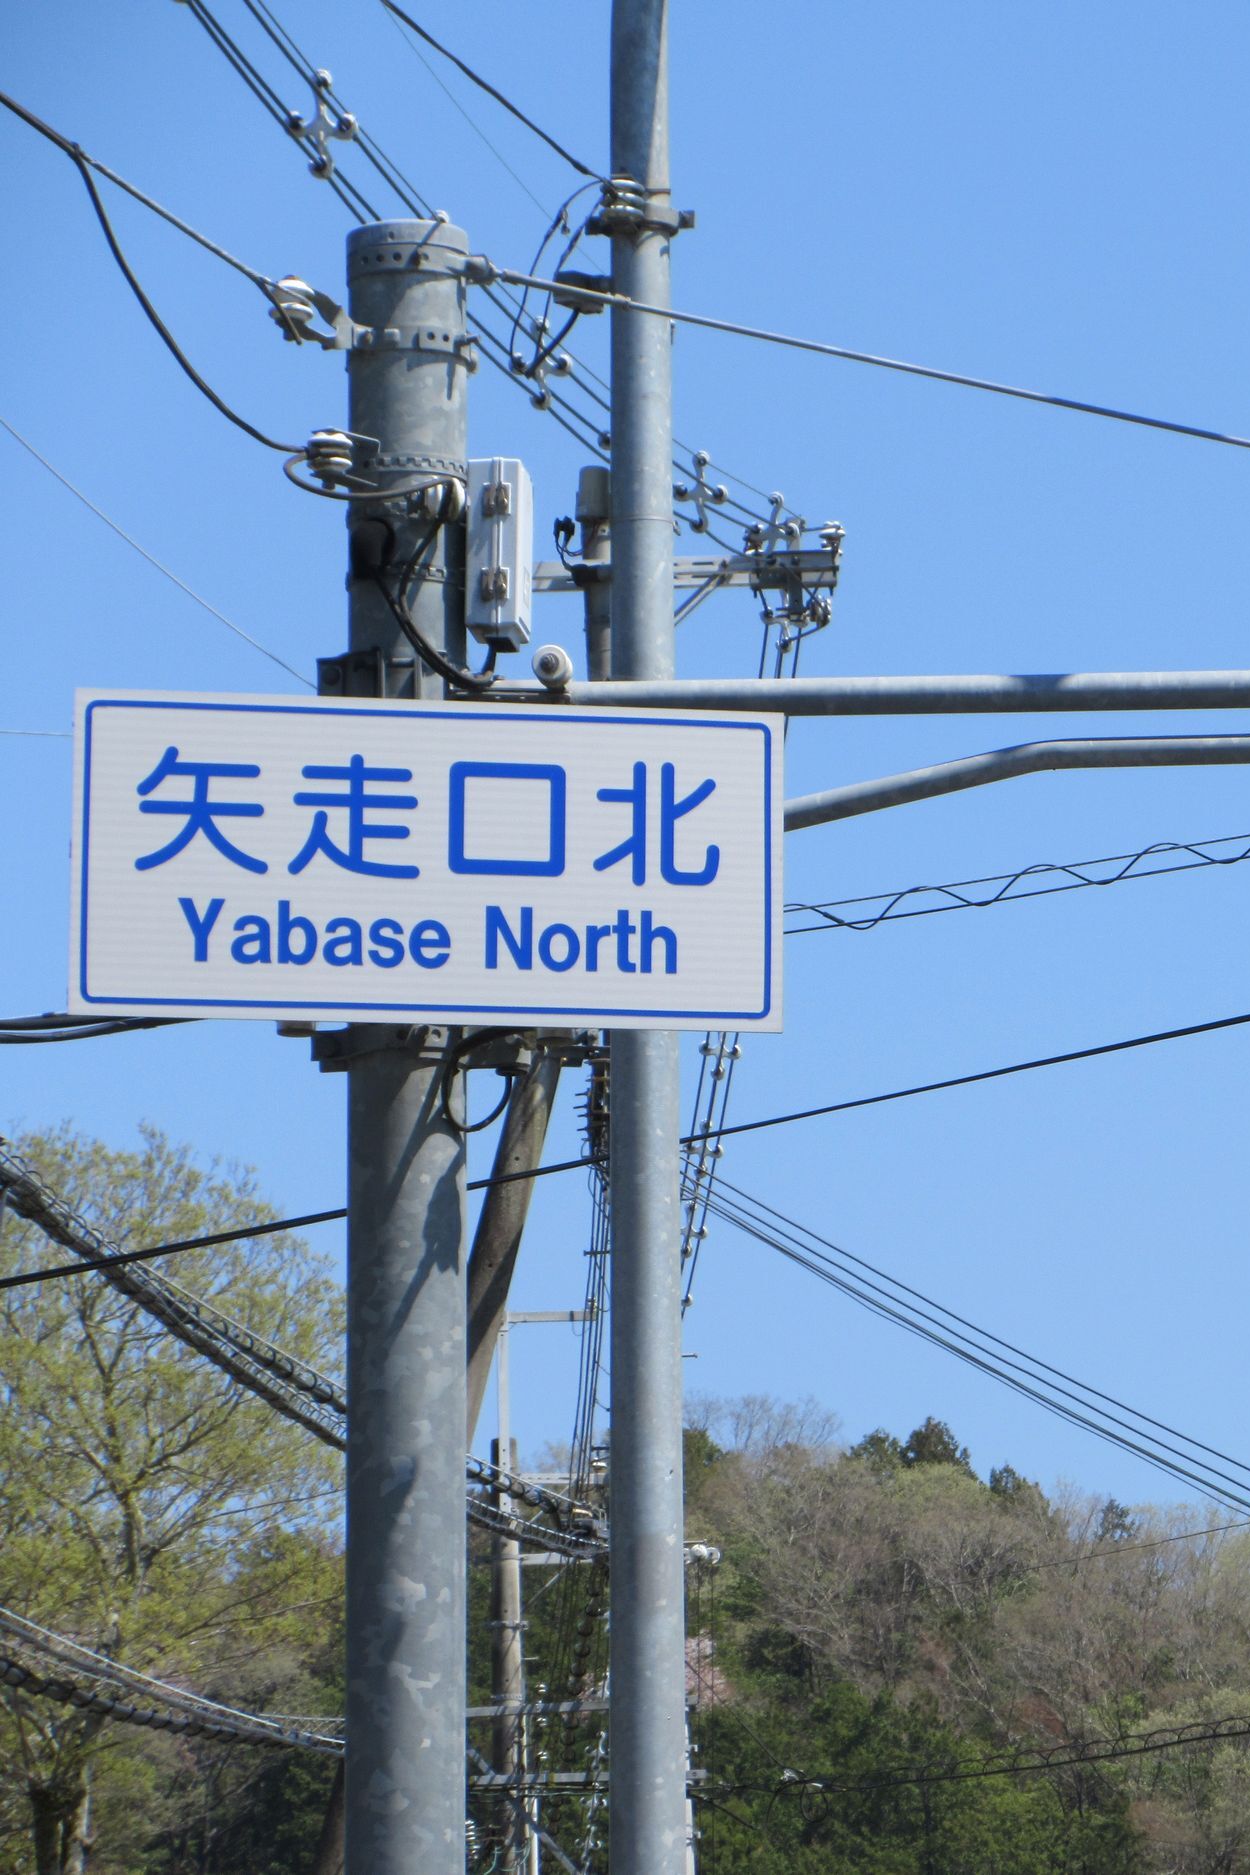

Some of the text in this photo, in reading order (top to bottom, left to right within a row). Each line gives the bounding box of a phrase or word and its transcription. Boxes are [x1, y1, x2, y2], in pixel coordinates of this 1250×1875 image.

[133, 745, 721, 887] 矢走口北
[177, 896, 679, 975] Yabase North
